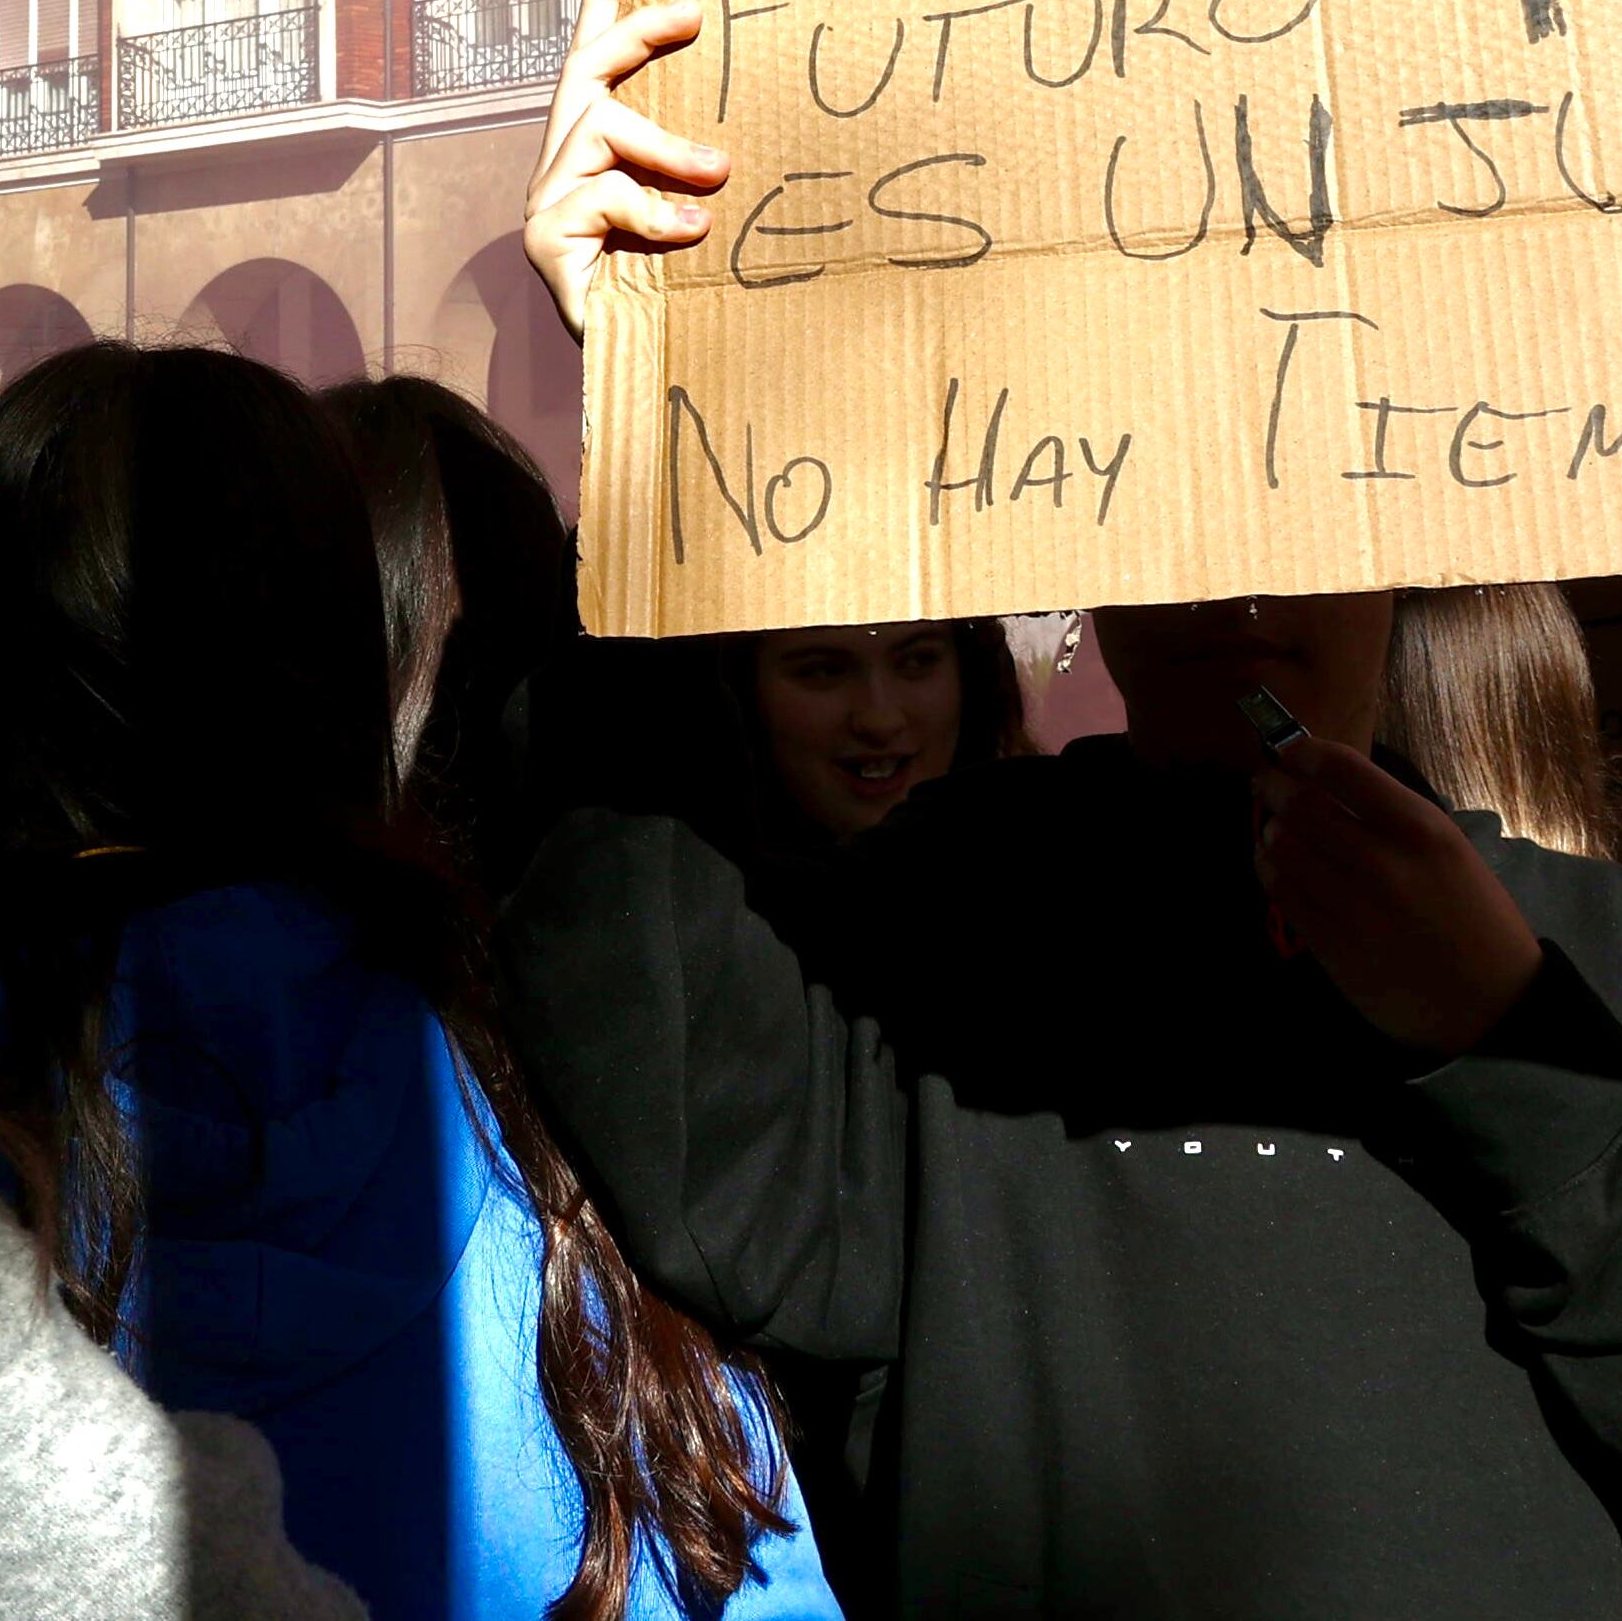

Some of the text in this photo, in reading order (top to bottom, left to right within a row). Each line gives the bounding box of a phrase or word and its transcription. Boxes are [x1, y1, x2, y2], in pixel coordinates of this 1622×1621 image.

[730, 153, 993, 289] ES
[1106, 92, 1334, 267] UN
[665, 382, 834, 565] NO
[924, 377, 1134, 527] HAY
